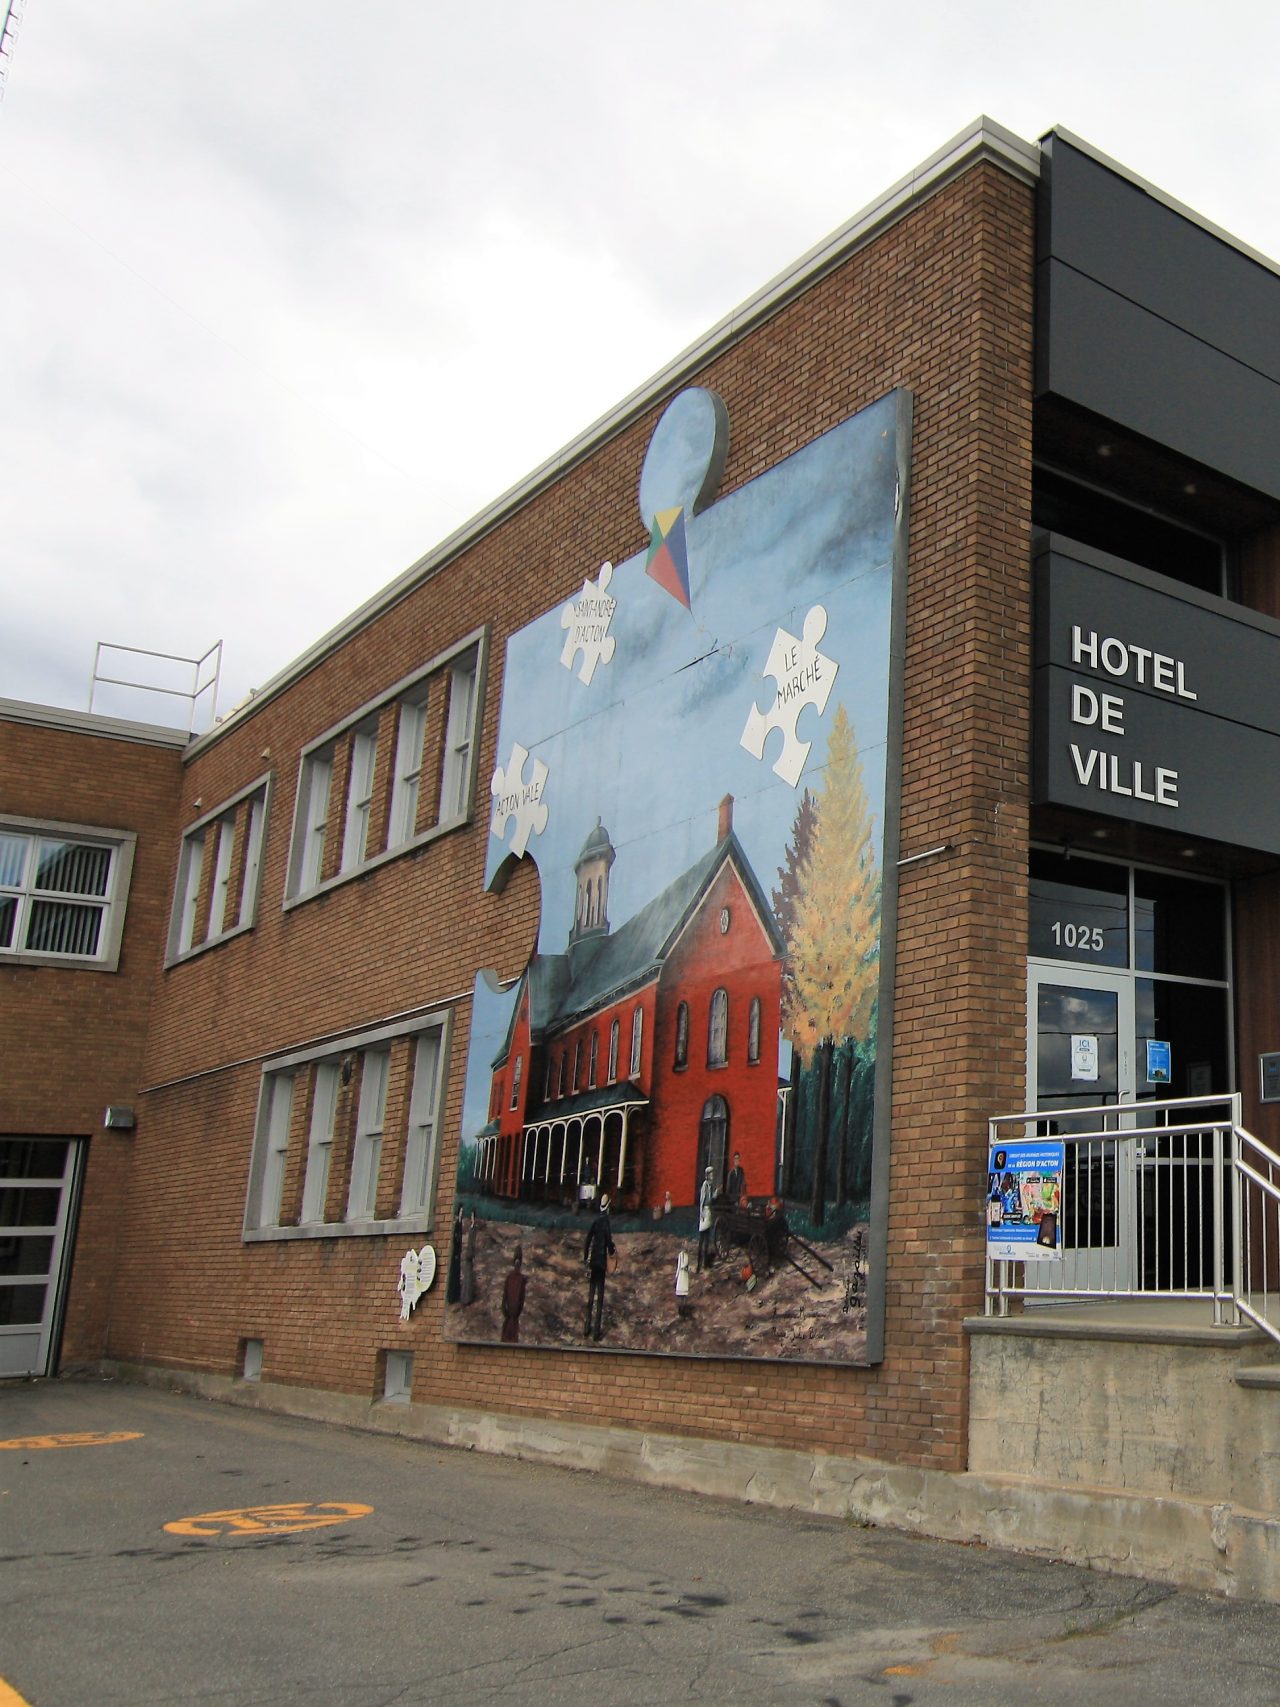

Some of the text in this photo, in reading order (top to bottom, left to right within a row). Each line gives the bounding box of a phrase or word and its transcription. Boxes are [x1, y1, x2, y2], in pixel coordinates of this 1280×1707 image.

[784, 645, 799, 673] LE
[1070, 625, 1197, 700] HOTEL
[777, 653, 823, 710] MARCHÉ
[1071, 684, 1125, 735] DE
[1069, 743, 1179, 808] VILLE
[496, 782, 540, 816] ACTON VALE
[1051, 921, 1104, 951] 1025
[1079, 1039, 1090, 1048] ICI
[1016, 1159, 1036, 1168] RÉGION
[1036, 1159, 1059, 1168] D'ACTON
